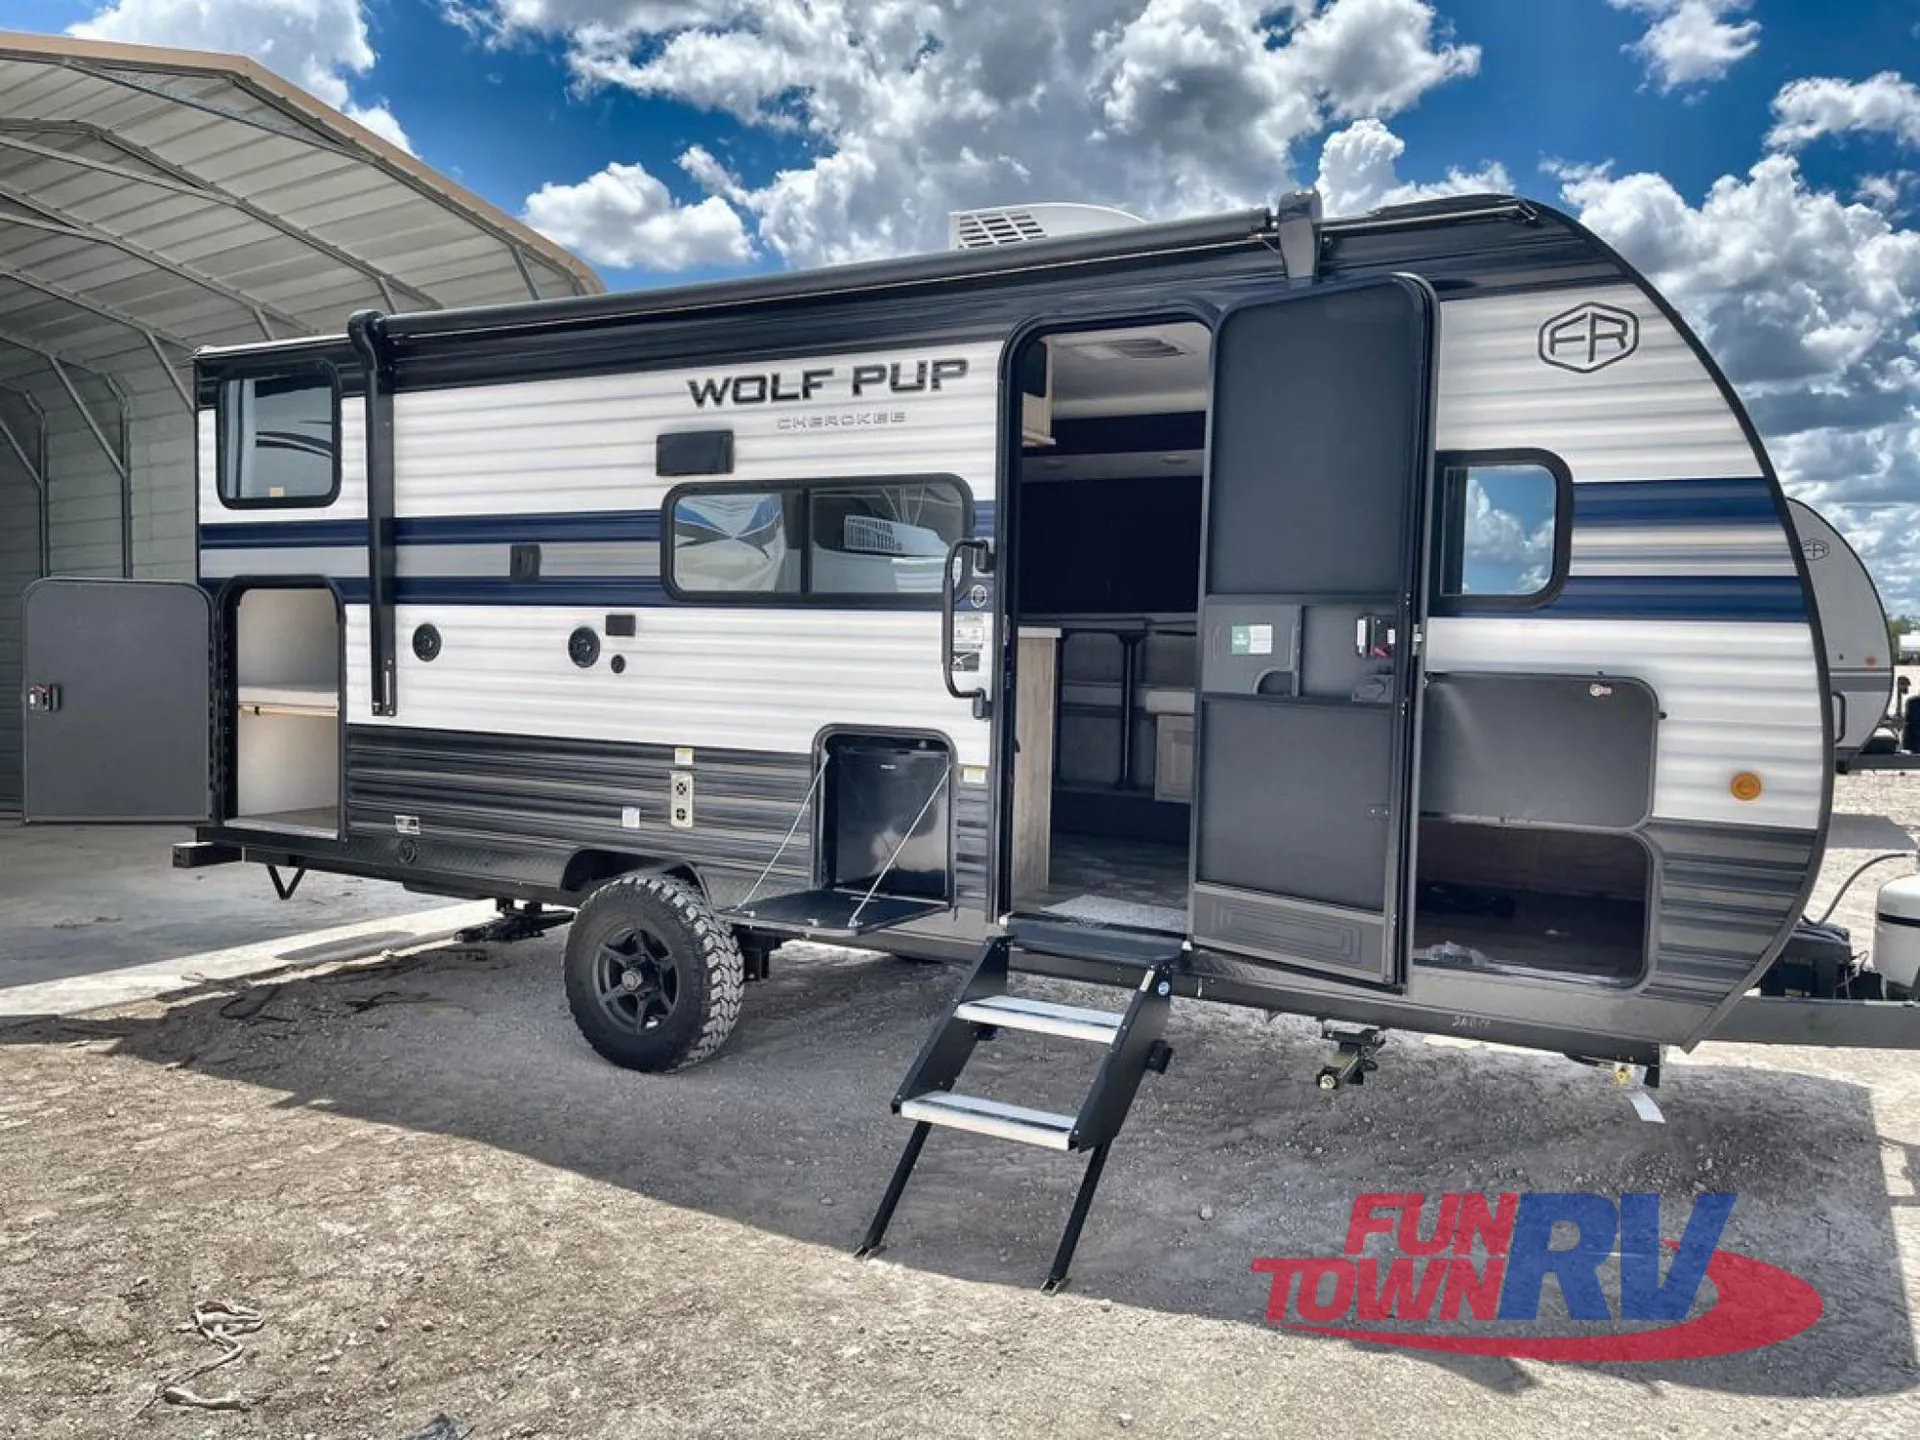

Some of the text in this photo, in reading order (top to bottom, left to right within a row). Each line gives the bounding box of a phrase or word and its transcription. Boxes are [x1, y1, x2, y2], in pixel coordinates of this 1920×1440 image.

[687, 358, 969, 407] WOLF PUP
[777, 412, 905, 430] CHEROKEE
